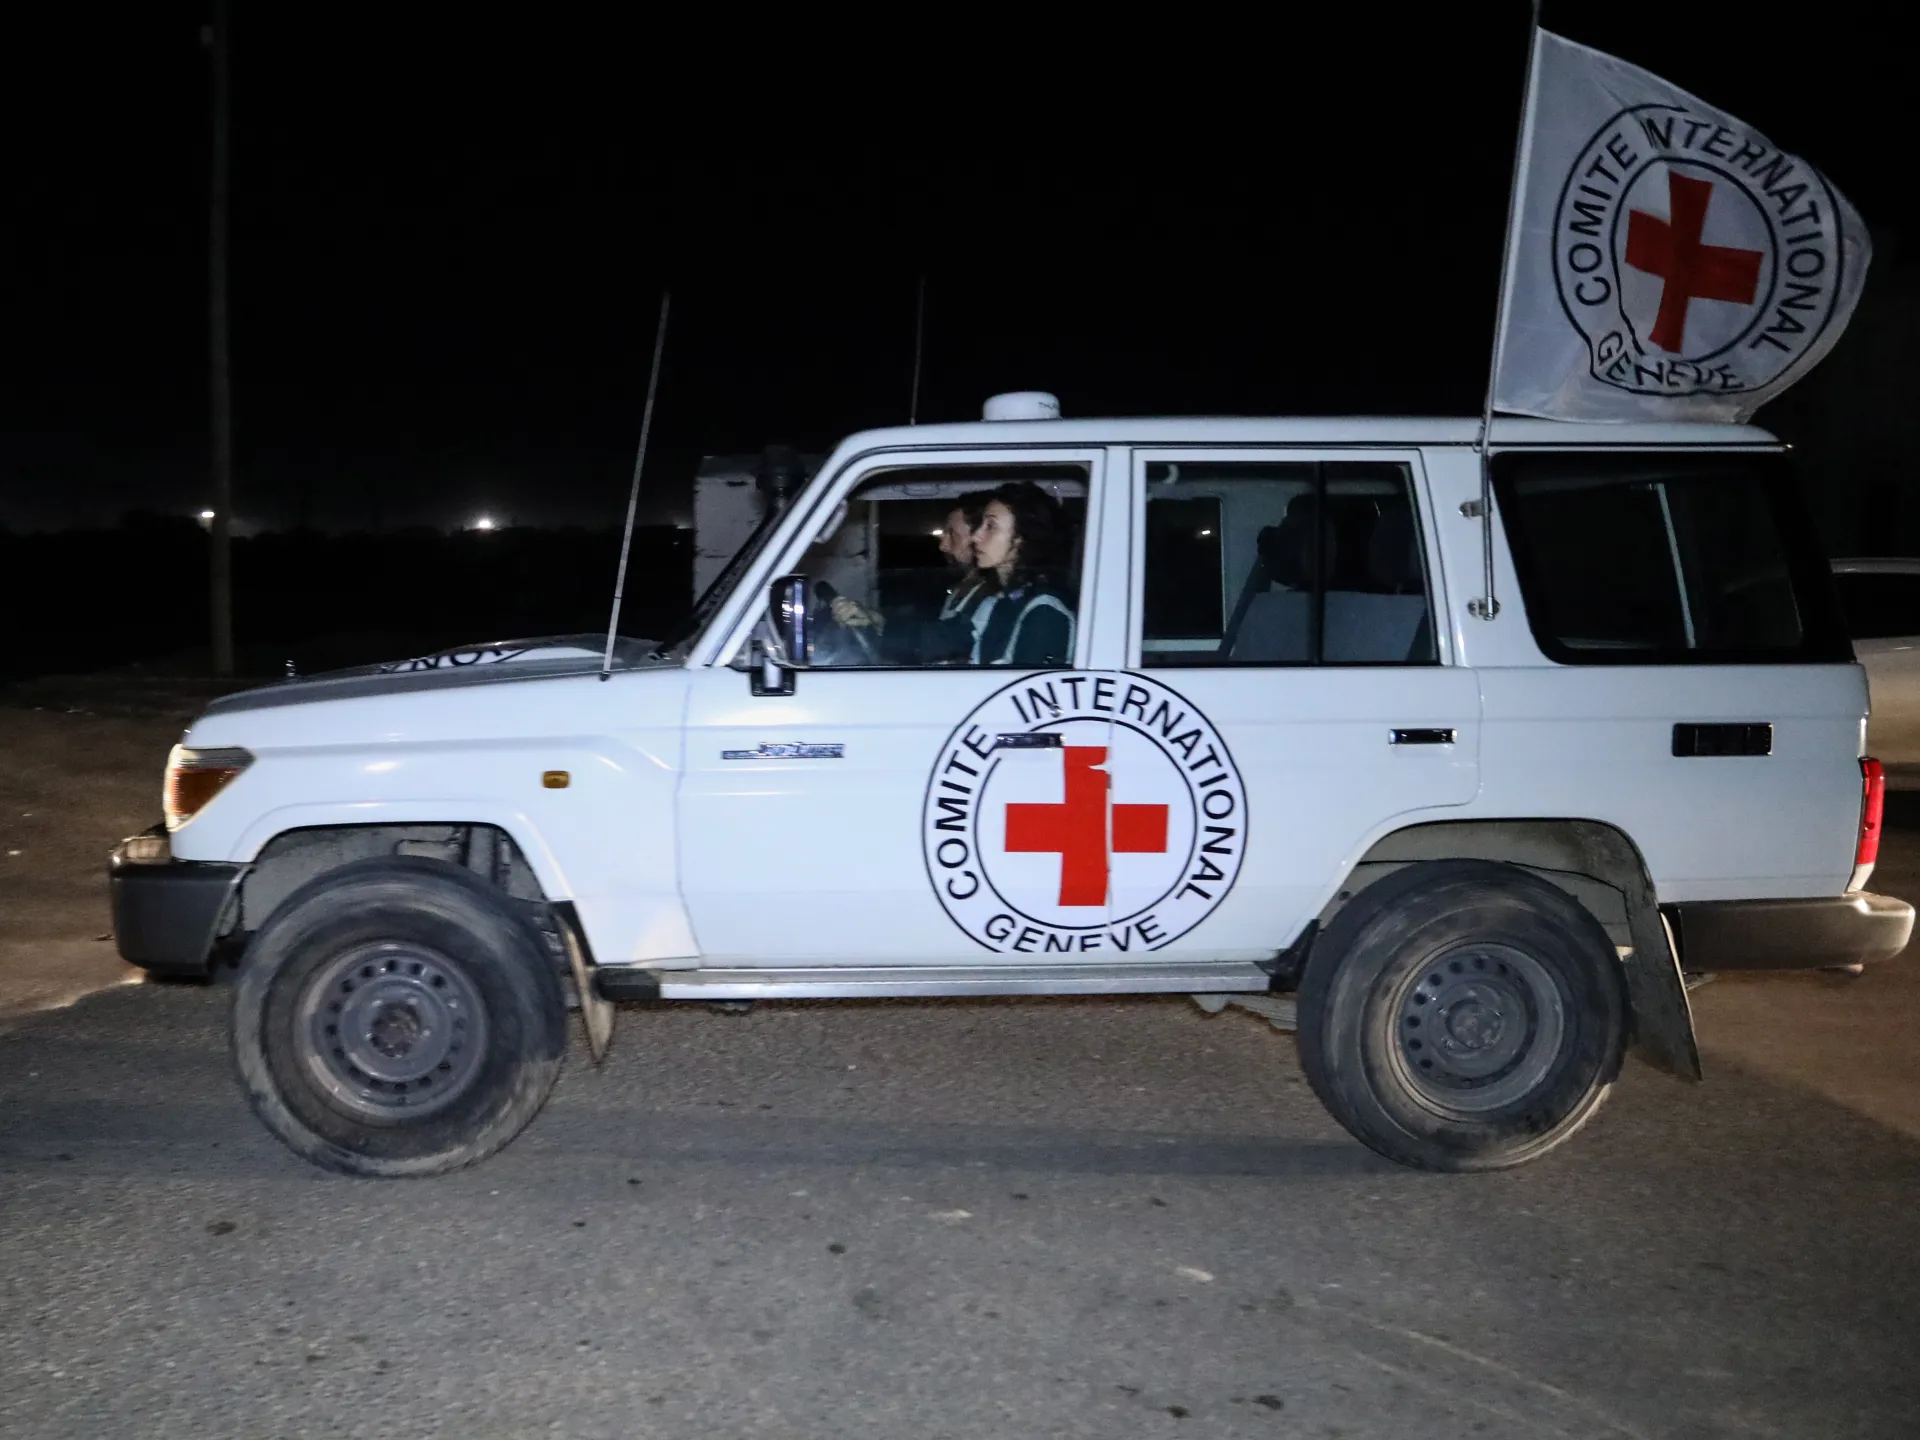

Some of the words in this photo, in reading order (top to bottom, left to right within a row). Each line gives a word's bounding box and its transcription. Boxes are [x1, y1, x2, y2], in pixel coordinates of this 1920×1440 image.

[1568, 133, 1638, 306] COMITE
[1598, 330, 1745, 388] GENEVE
[935, 725, 997, 900] COMITE
[1010, 676, 1236, 901] INTERNATIONAL
[984, 914, 1168, 952] GENEVE
